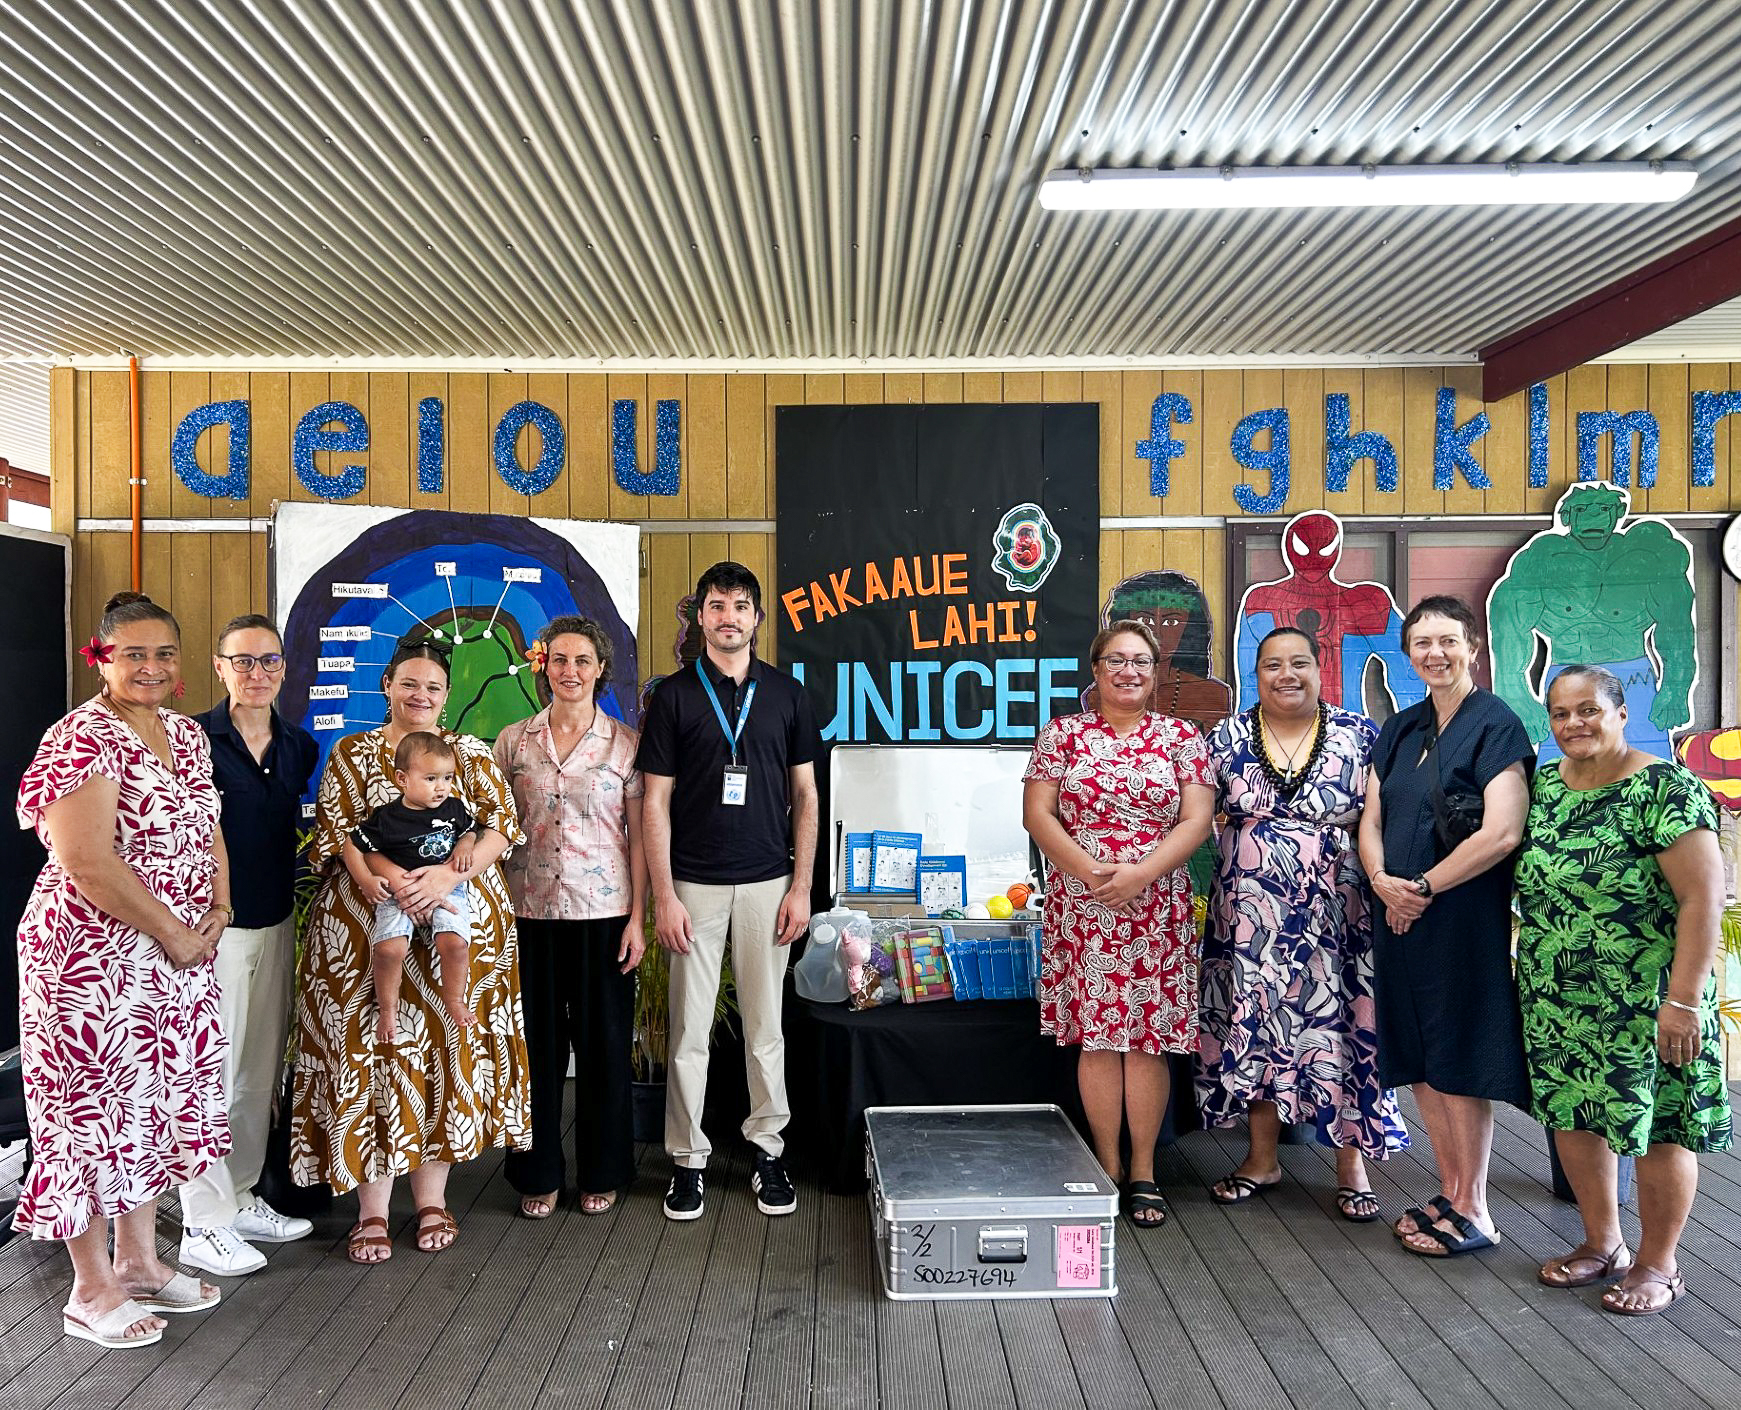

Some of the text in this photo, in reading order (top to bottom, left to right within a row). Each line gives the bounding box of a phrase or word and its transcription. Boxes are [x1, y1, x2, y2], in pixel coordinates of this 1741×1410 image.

[333, 585, 385, 596] Hikutava
[781, 553, 969, 632] FAKAAUE
[909, 601, 1038, 650] LAHI!
[310, 687, 345, 697] Makefu
[315, 716, 336, 726] Alofi
